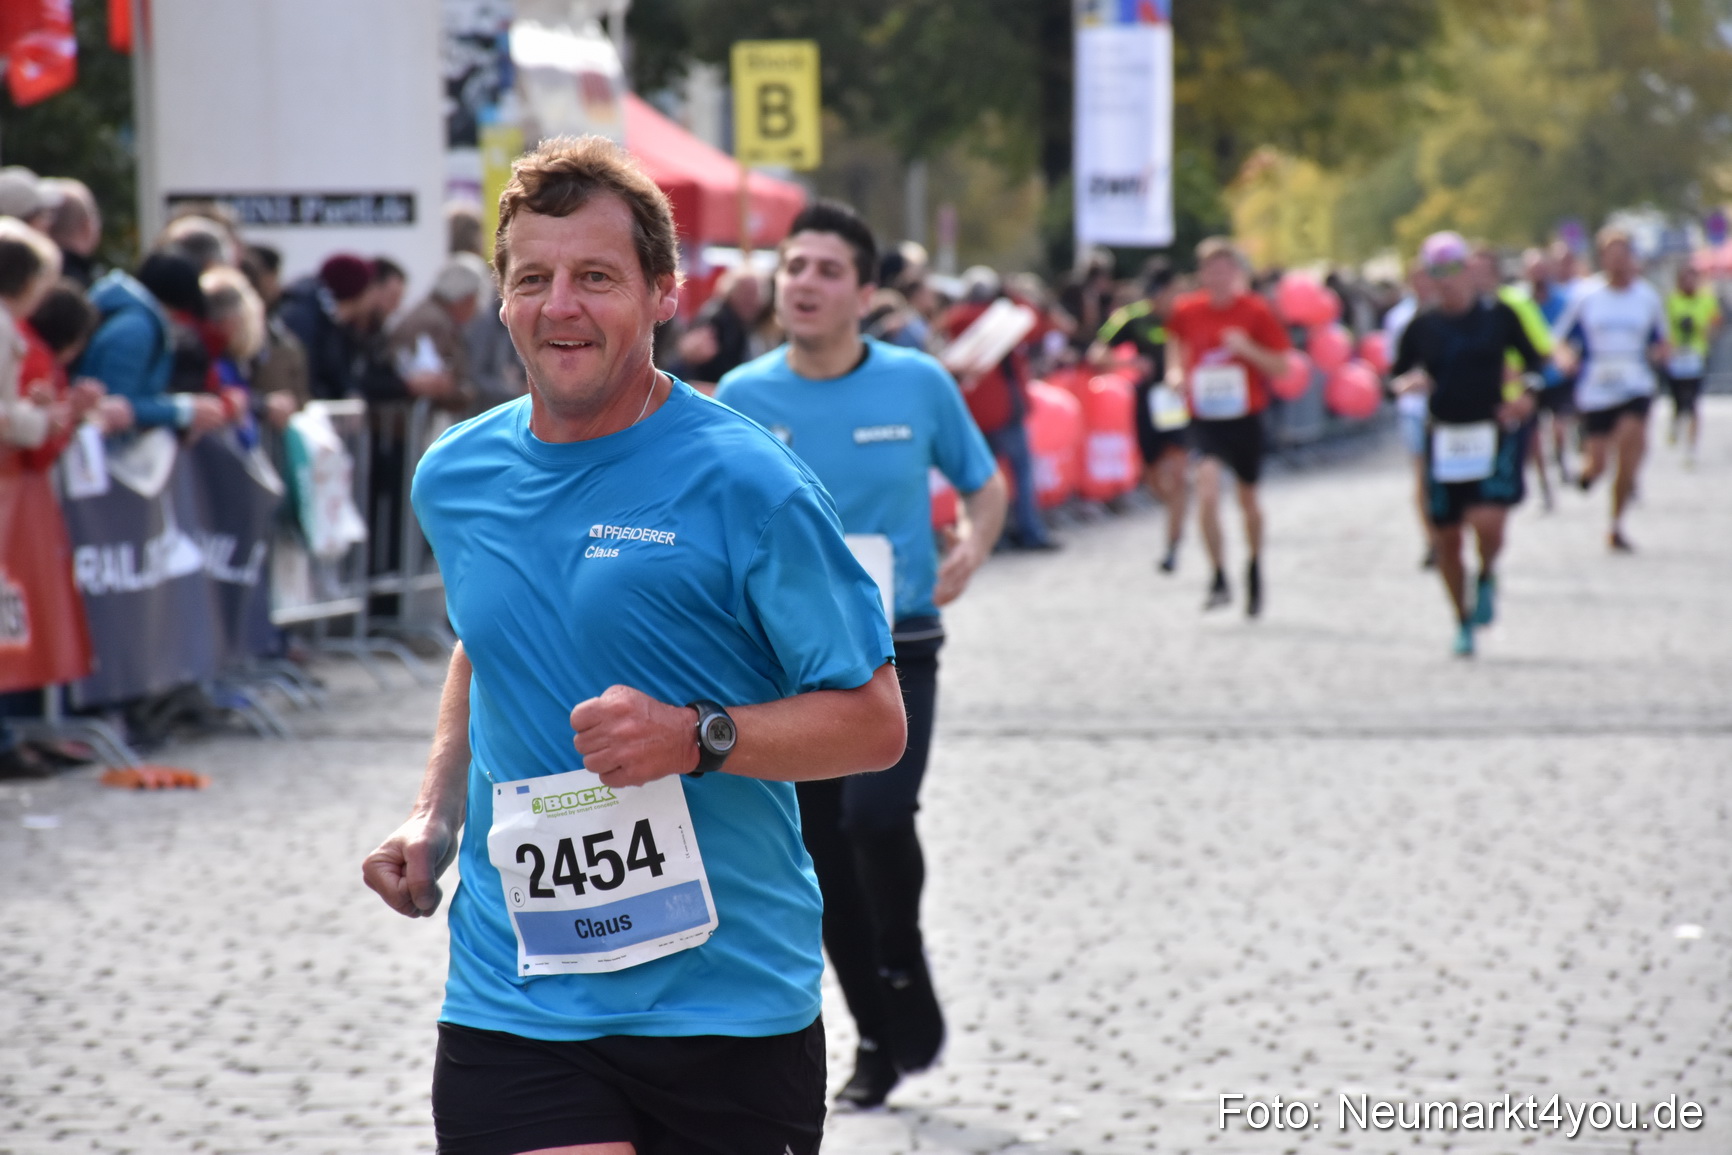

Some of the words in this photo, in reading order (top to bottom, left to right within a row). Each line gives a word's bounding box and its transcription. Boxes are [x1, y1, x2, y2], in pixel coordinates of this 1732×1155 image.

[758, 84, 796, 138] B
[604, 525, 676, 546] PFLEIDERER
[584, 545, 620, 559] Claus
[544, 785, 617, 812] BOCK
[546, 809, 568, 819] inspired
[576, 806, 593, 814] smart
[593, 799, 620, 810] concepts
[516, 818, 666, 898] 2454
[514, 891, 521, 903] C
[574, 913, 633, 939] Claus
